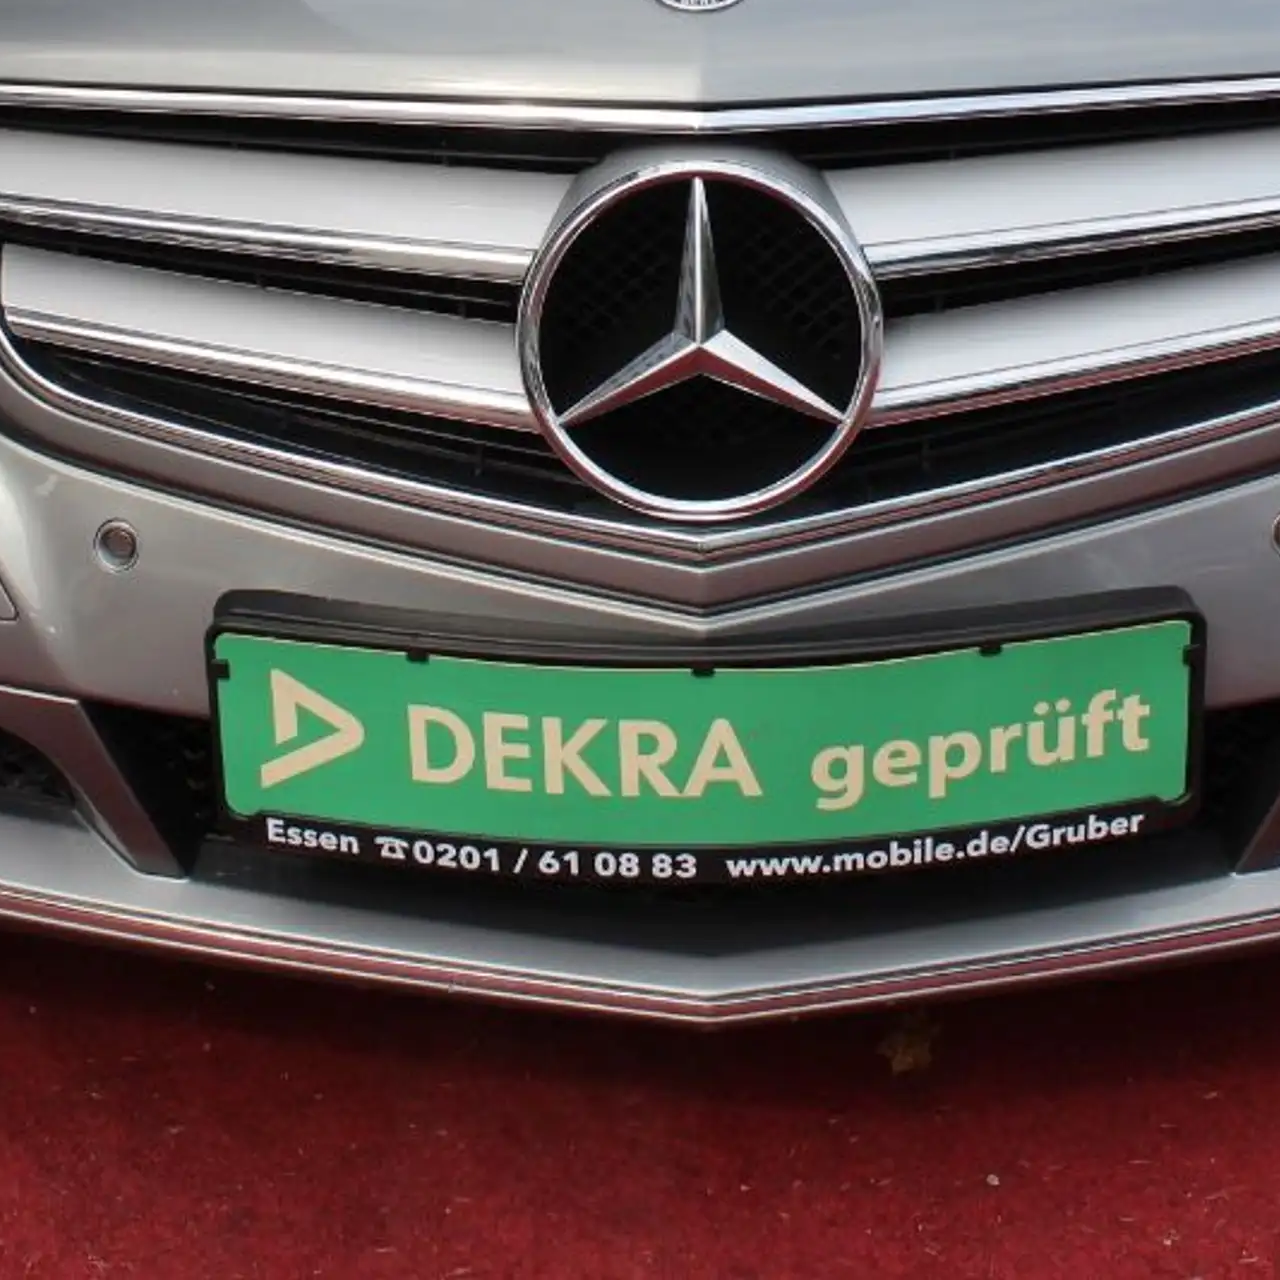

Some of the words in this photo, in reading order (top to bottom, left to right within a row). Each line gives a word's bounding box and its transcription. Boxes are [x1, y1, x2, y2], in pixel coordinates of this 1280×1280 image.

[407, 703, 763, 798] DEKRA
[811, 689, 1151, 811] geprüft
[266, 817, 359, 855] Essen
[414, 839, 500, 872] 0201
[538, 851, 580, 876] 61
[594, 853, 640, 877] 08
[651, 854, 697, 879] 83
[726, 812, 1145, 879] www.mobile.de/Gruber
